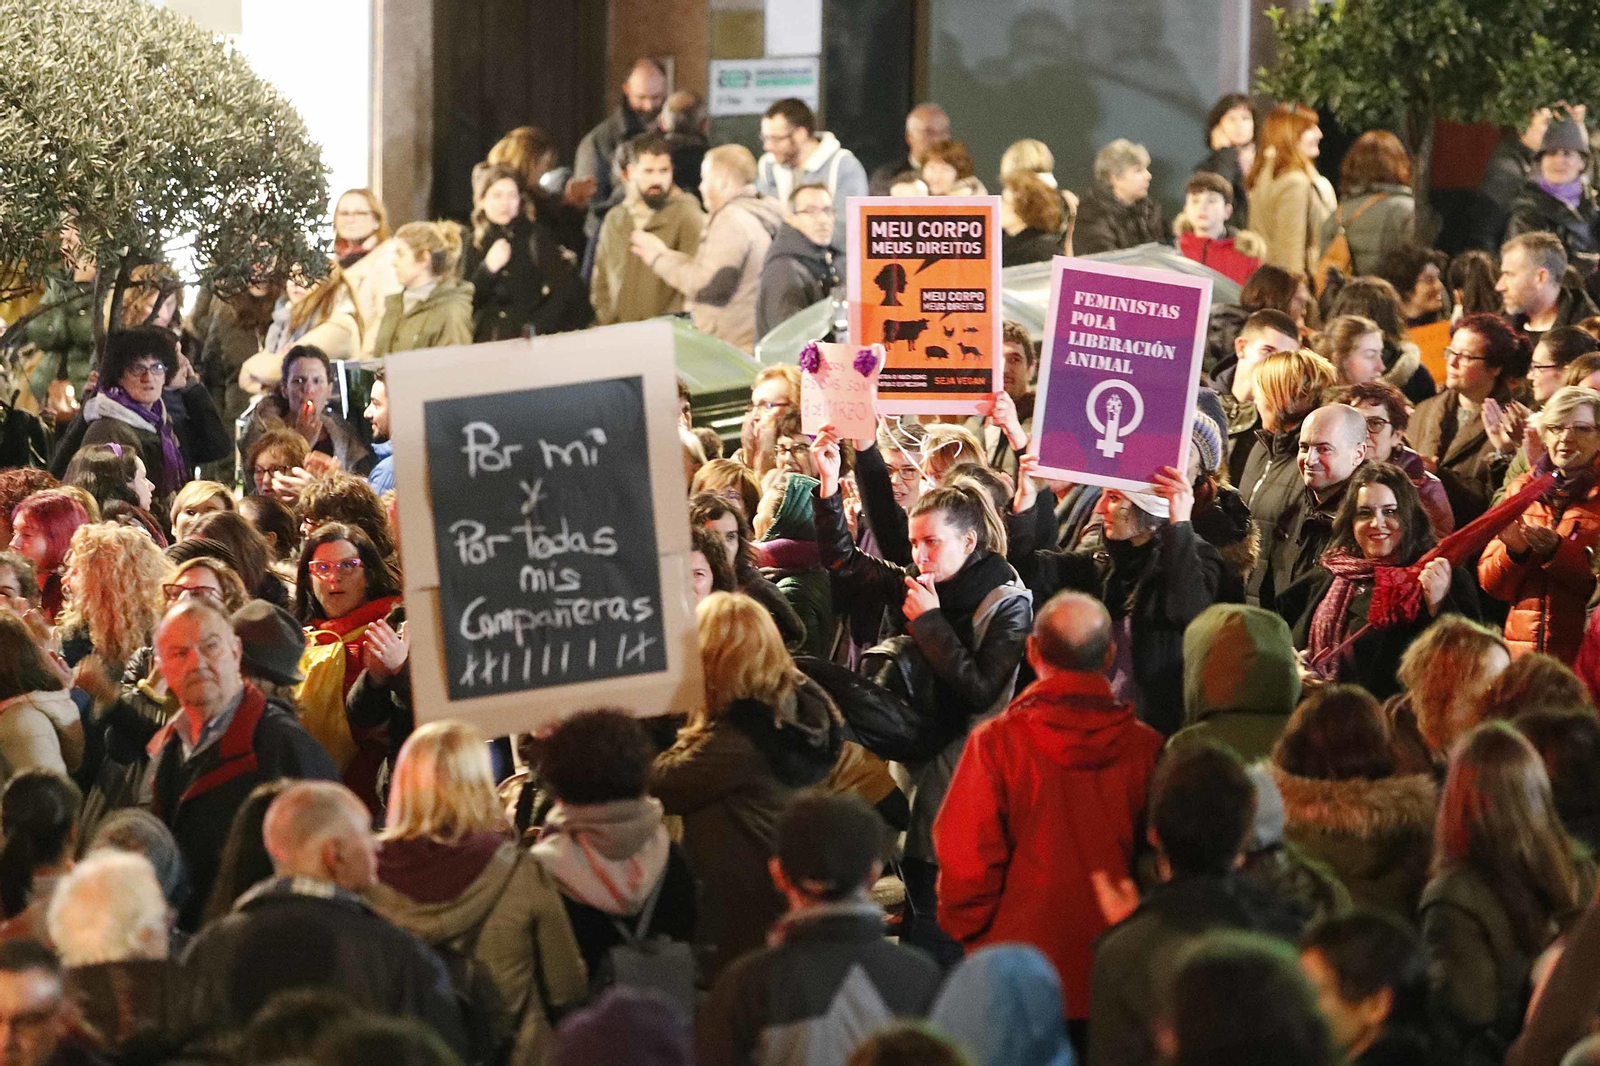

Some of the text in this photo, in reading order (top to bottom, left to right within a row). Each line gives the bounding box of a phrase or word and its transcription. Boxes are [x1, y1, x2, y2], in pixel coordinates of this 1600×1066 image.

[871, 221, 983, 238] MEU CORPO
[871, 241, 982, 255] MEUS DIREITOS
[922, 291, 985, 303] MEU CORPO
[922, 302, 947, 311] MEUS
[1073, 290, 1181, 320] FEMINISTAS
[1070, 310, 1117, 331] POLA
[1067, 330, 1177, 360] LIBERACIÓN
[1064, 351, 1134, 375] ANIMAL
[934, 376, 986, 385] SEJA VEGAN
[461, 421, 523, 478] Por
[449, 519, 512, 565] Por
[519, 561, 582, 592] mis
